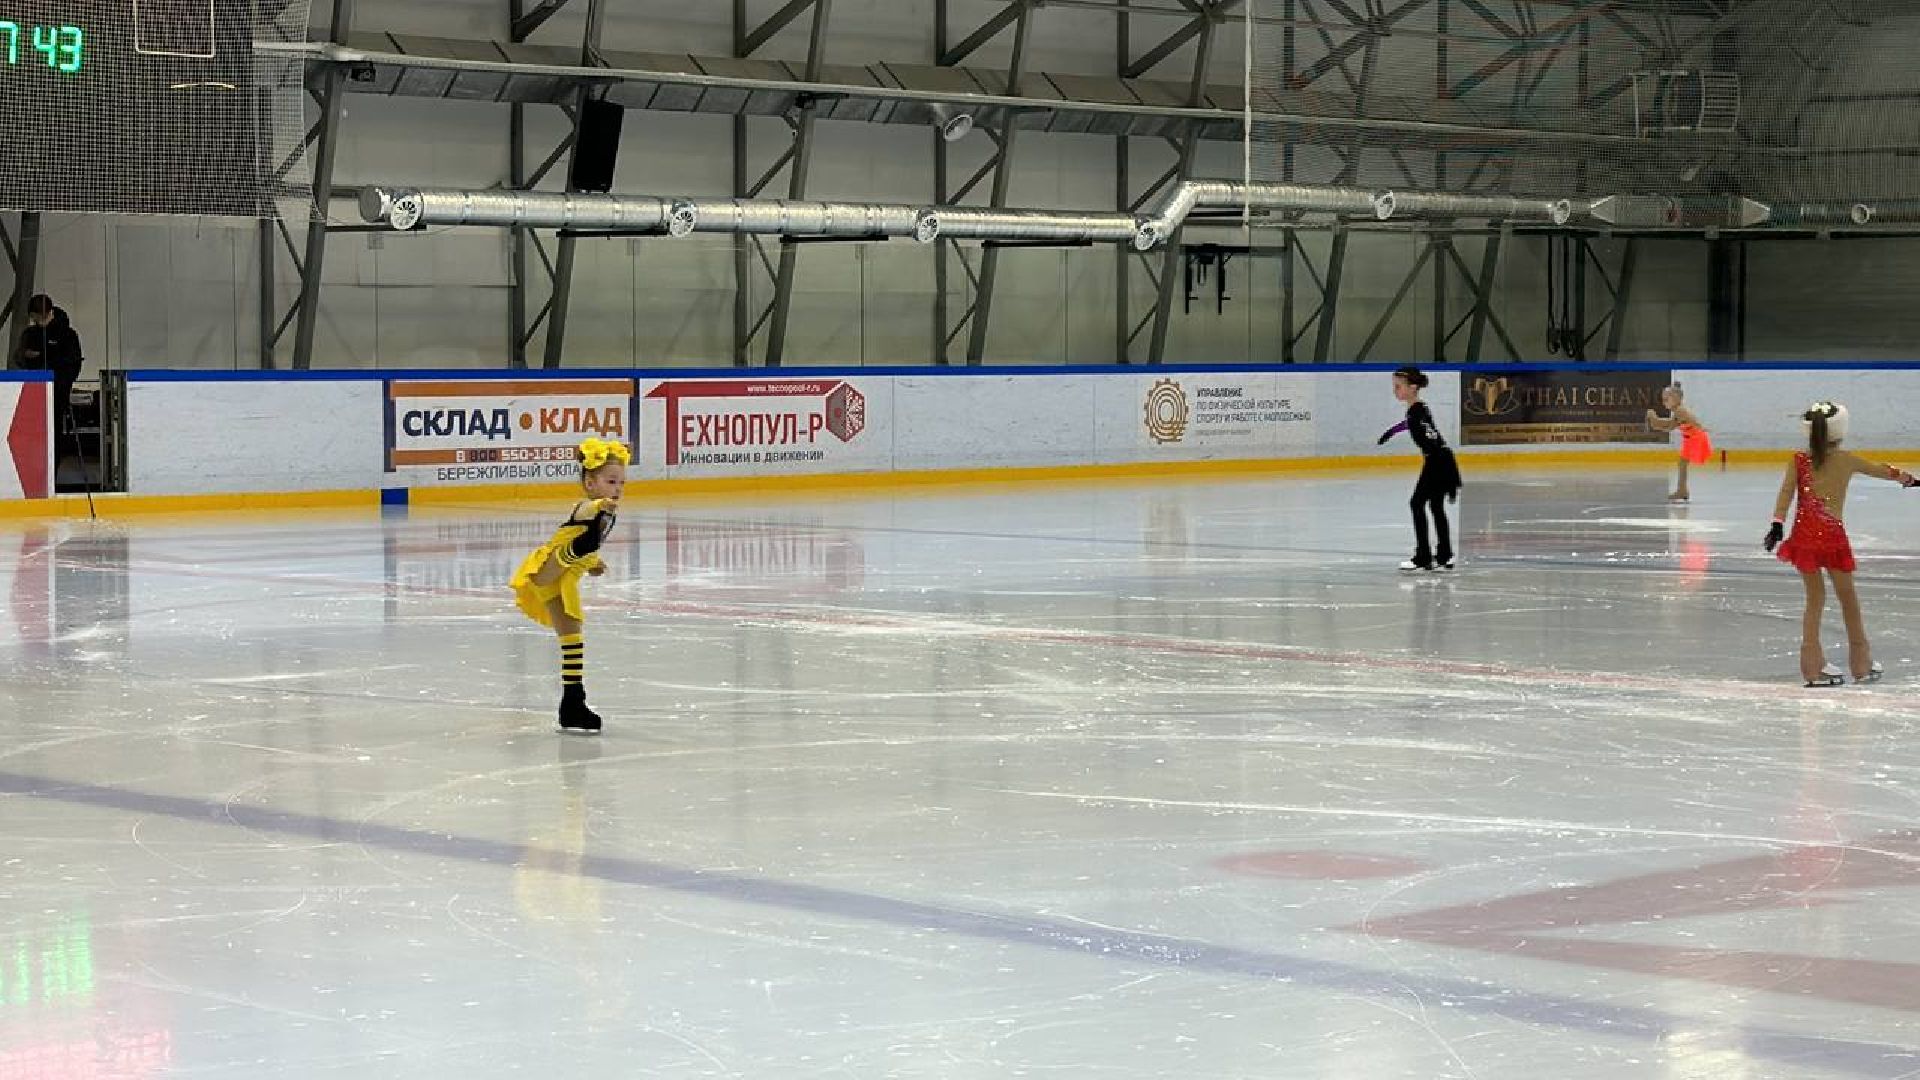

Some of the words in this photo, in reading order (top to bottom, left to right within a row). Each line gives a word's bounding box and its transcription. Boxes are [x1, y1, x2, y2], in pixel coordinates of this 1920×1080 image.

[1197, 387, 1243, 398] УПРАВЛЕНИЕ
[1523, 385, 1580, 406] THAI
[402, 408, 511, 439] СКЛАД
[540, 407, 623, 437] КЛАД
[456, 450, 466, 462] 8
[681, 451, 751, 465] Инновации
[753, 452, 760, 463] в
[764, 451, 824, 464] движении
[437, 463, 541, 481] БЕРЕЖЛИВЫЙ
[545, 463, 580, 478] СКЛА
